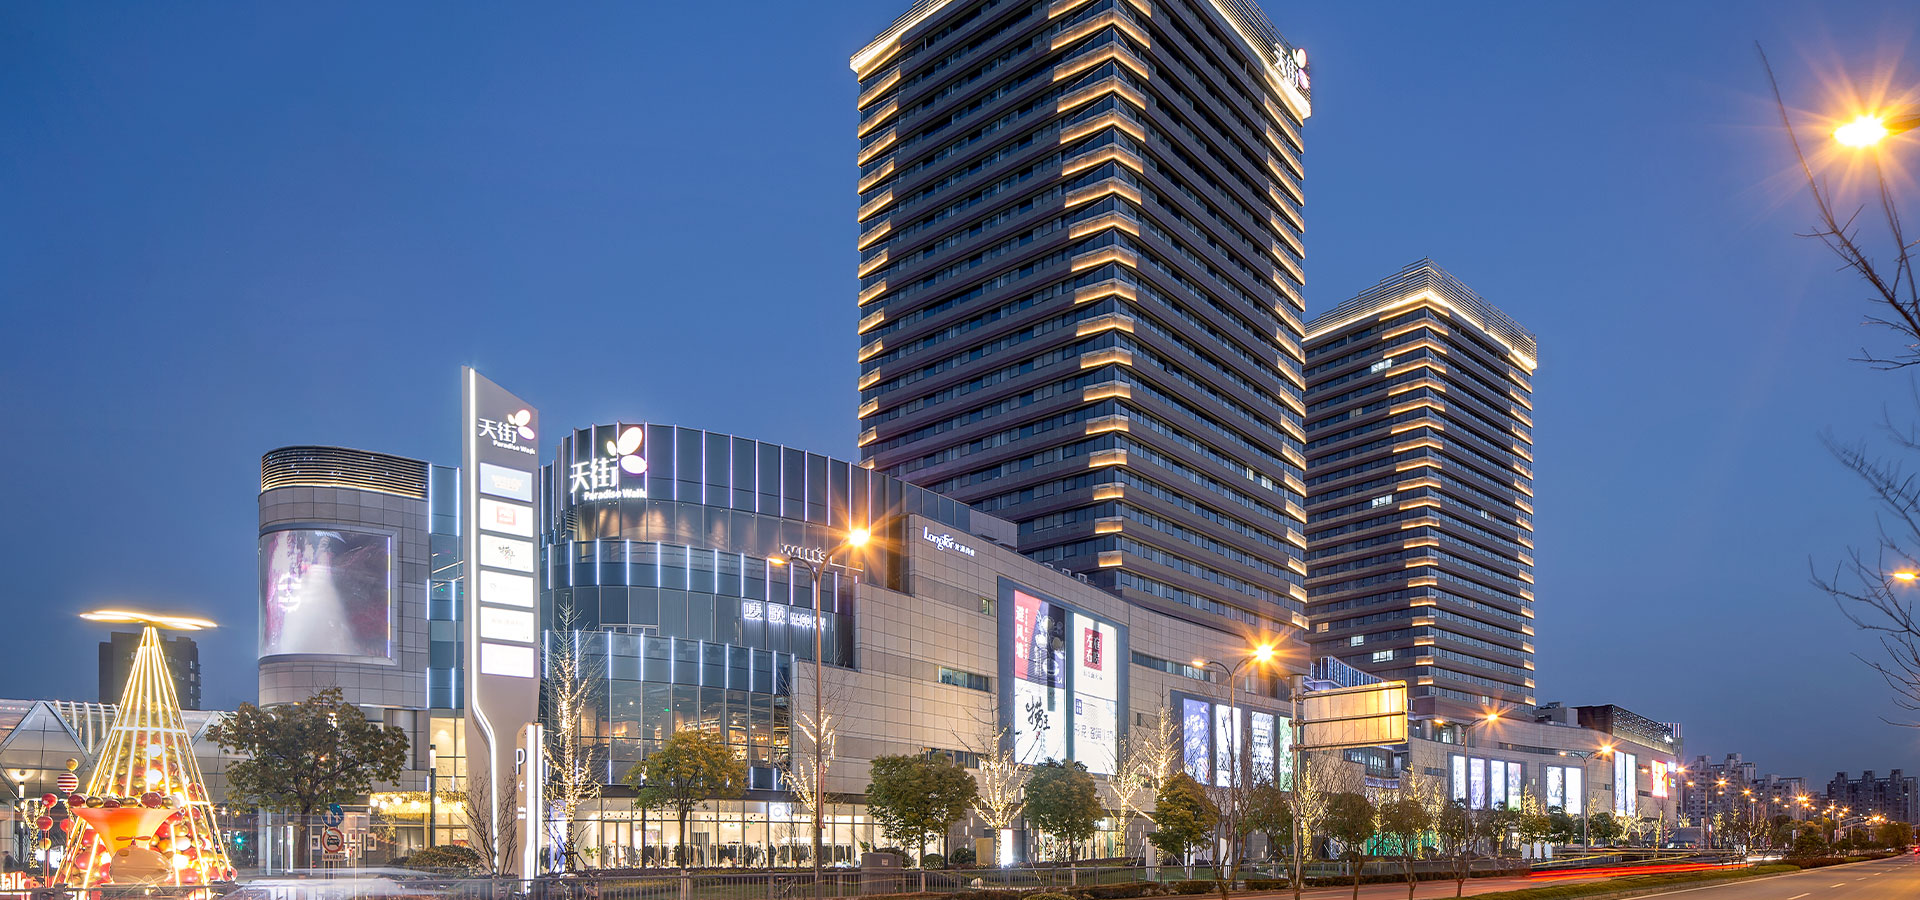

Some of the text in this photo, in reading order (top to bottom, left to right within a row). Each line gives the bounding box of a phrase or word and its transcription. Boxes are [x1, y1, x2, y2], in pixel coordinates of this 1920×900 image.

[1273, 42, 1299, 88] 天街
[477, 417, 518, 444] 天街
[493, 440, 536, 455] Paradise Walk
[569, 457, 618, 494] 天街
[584, 487, 647, 501] Paradise Walk
[515, 747, 527, 776] P
